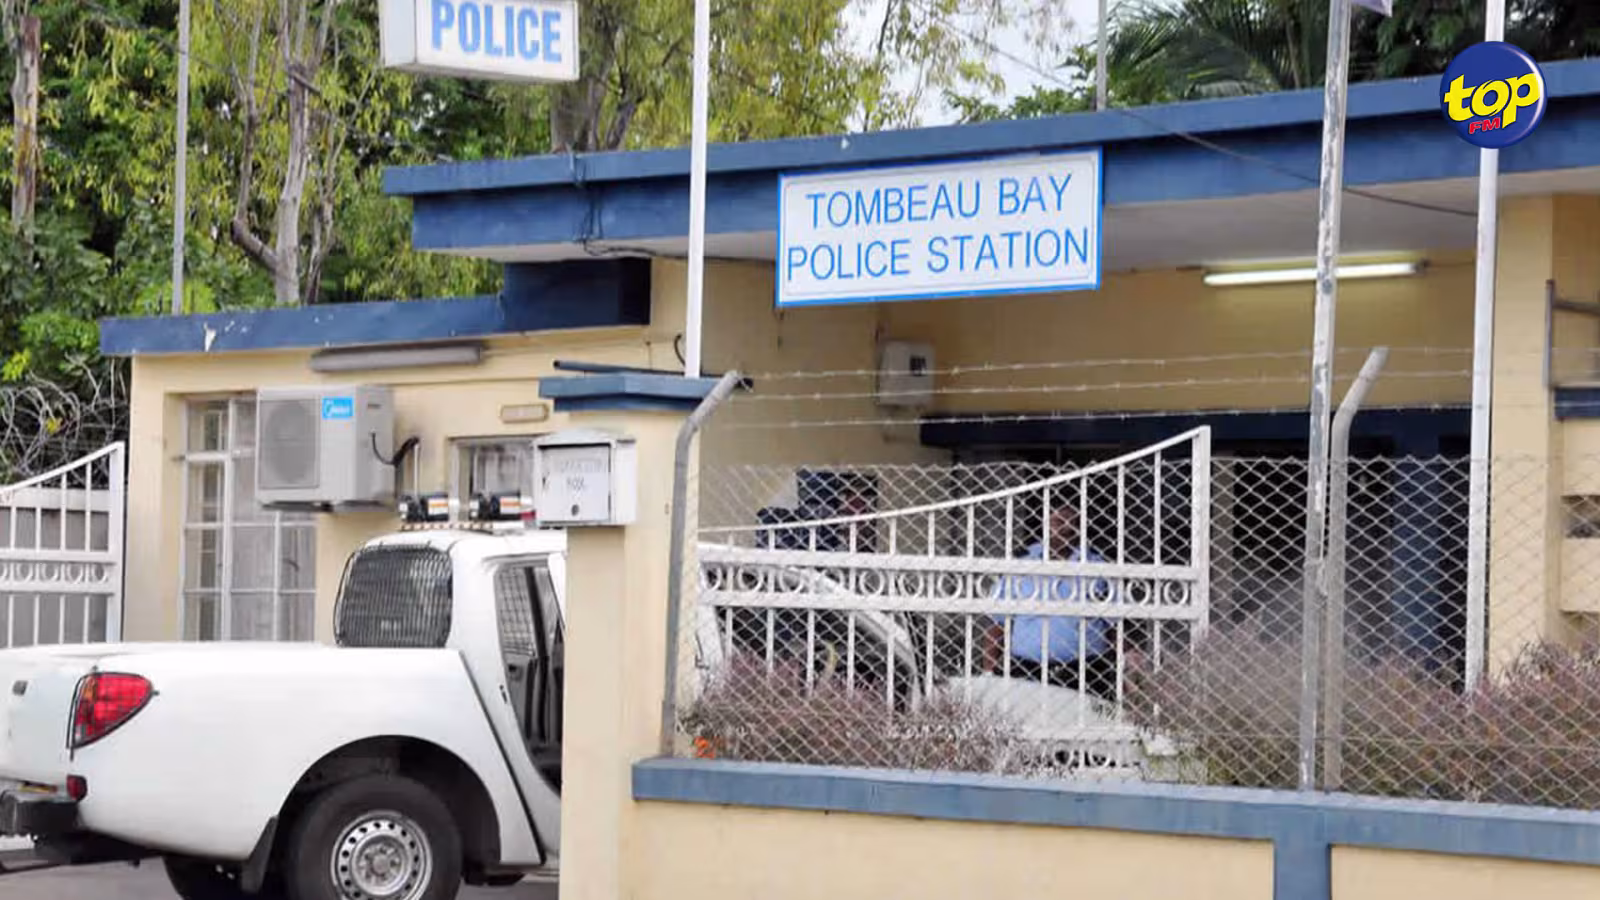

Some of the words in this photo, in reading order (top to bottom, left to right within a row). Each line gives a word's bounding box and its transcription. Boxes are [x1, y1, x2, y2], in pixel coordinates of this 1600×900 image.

[431, 0, 562, 63] POLICE
[806, 181, 980, 229] TOMBEAU
[999, 174, 1072, 216] BAY
[787, 239, 910, 281] POLICE
[927, 227, 1088, 273] STATION
